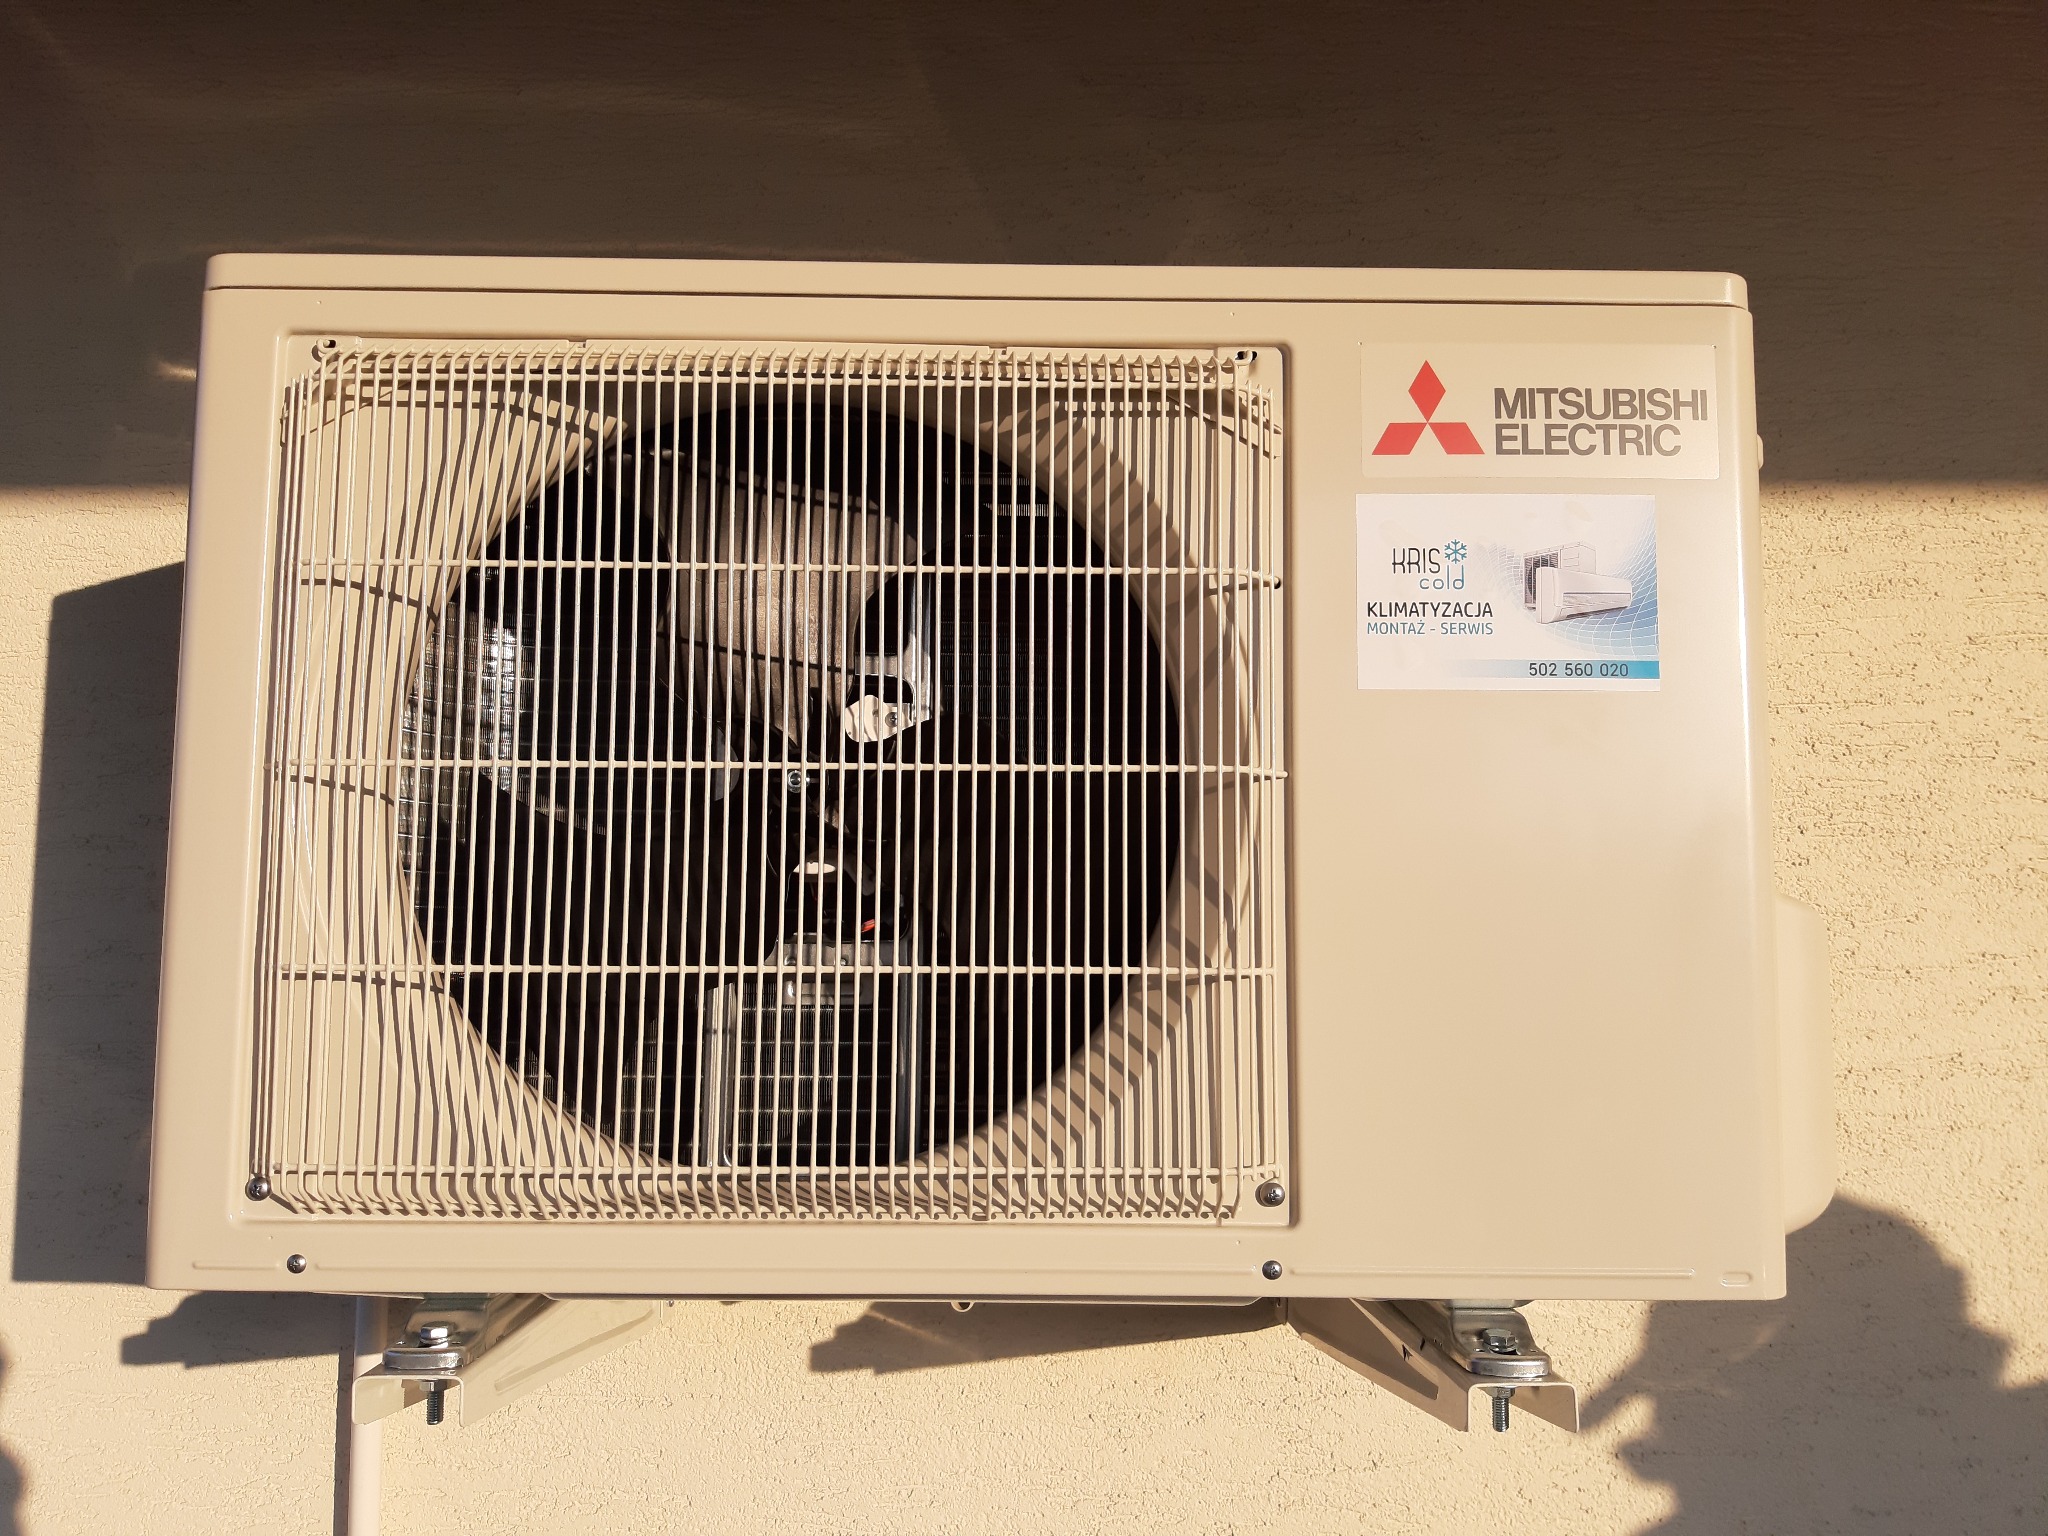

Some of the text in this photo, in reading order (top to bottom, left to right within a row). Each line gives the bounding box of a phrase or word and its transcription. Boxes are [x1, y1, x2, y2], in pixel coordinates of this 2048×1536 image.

[1494, 387, 1708, 421] MITSUBISHI
[1495, 423, 1682, 457] ELECTRIC
[1391, 548, 1441, 574] KRIS
[1419, 565, 1465, 590] cold
[1366, 601, 1494, 618] KLIMATYZACJA
[1366, 619, 1426, 635] MONTAŻ
[1440, 622, 1494, 635] SERWIS
[1528, 662, 1629, 677] 502 560 020
